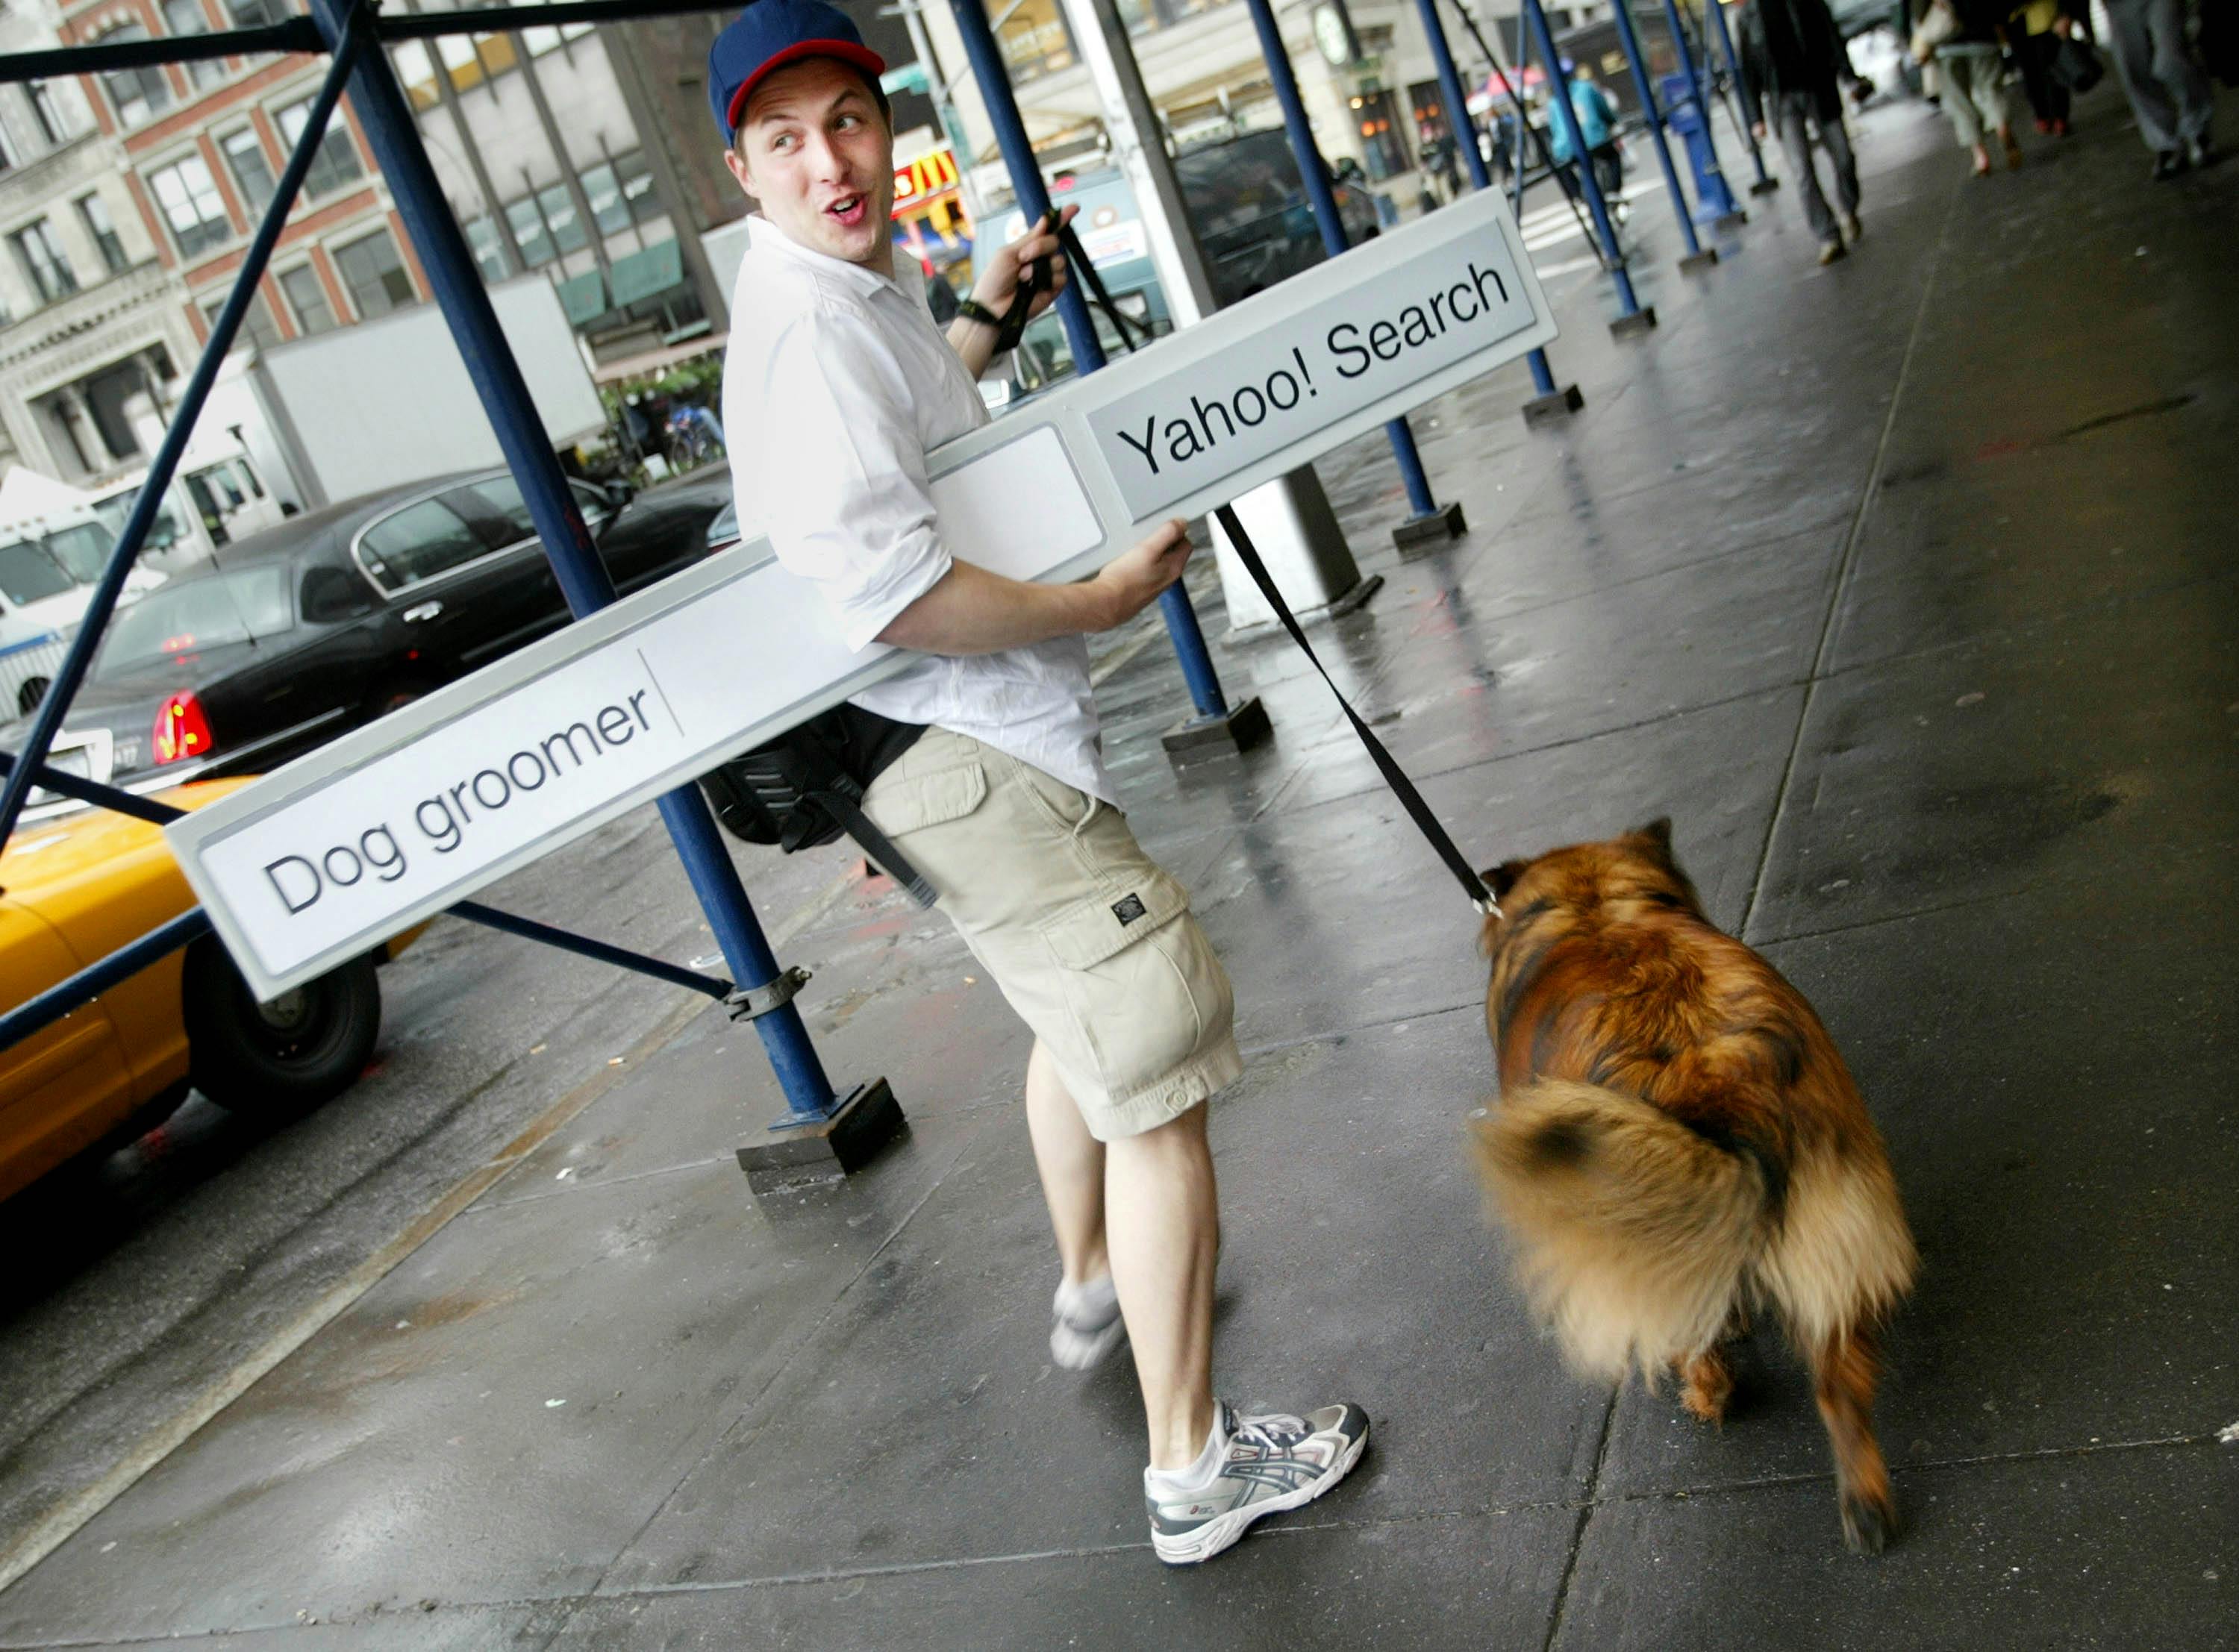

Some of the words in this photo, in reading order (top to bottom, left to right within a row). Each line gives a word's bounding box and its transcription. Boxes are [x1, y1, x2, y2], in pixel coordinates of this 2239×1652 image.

[1117, 347, 1318, 475] Yahoo!
[1326, 263, 1509, 378] Search
[264, 823, 407, 916] Dog
[415, 689, 649, 854] groomer
